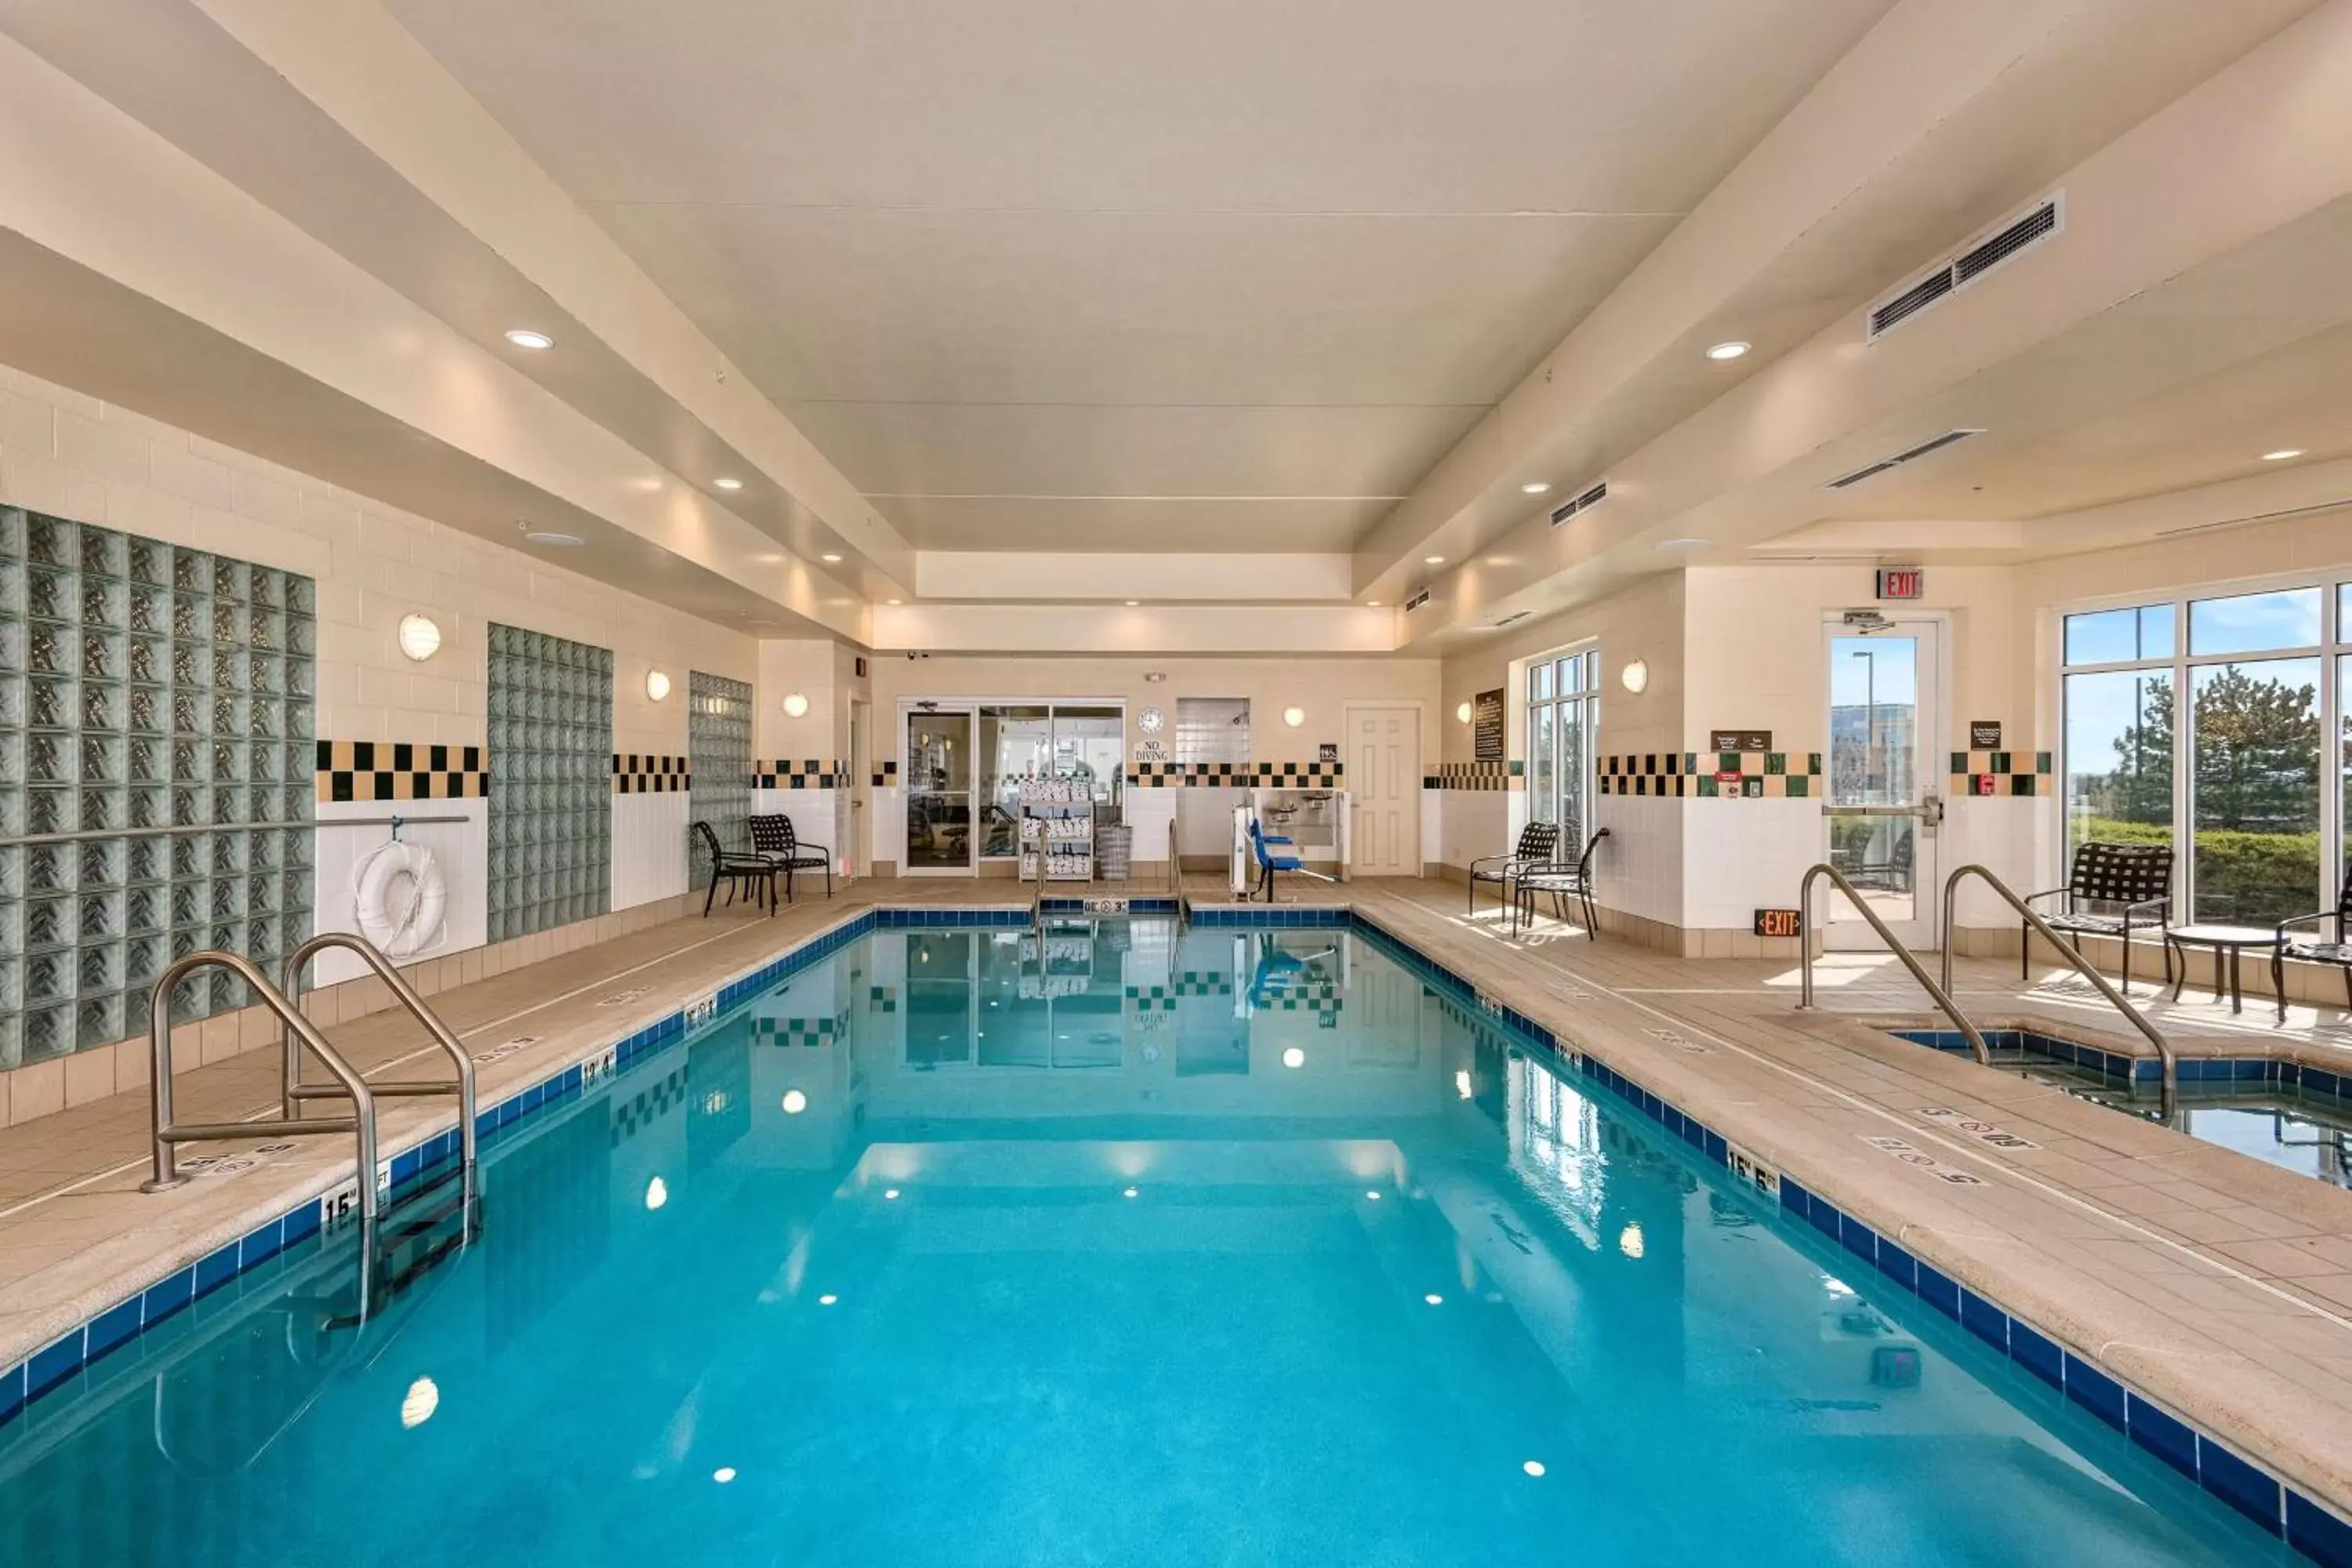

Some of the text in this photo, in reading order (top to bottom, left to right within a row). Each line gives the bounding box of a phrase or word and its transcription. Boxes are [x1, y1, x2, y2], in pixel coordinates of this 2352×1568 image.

[1887, 572, 1918, 596] EXIT
[1145, 741, 1160, 750] NO
[1136, 750, 1167, 761] DIVING
[1765, 910, 1796, 935] EXIT
